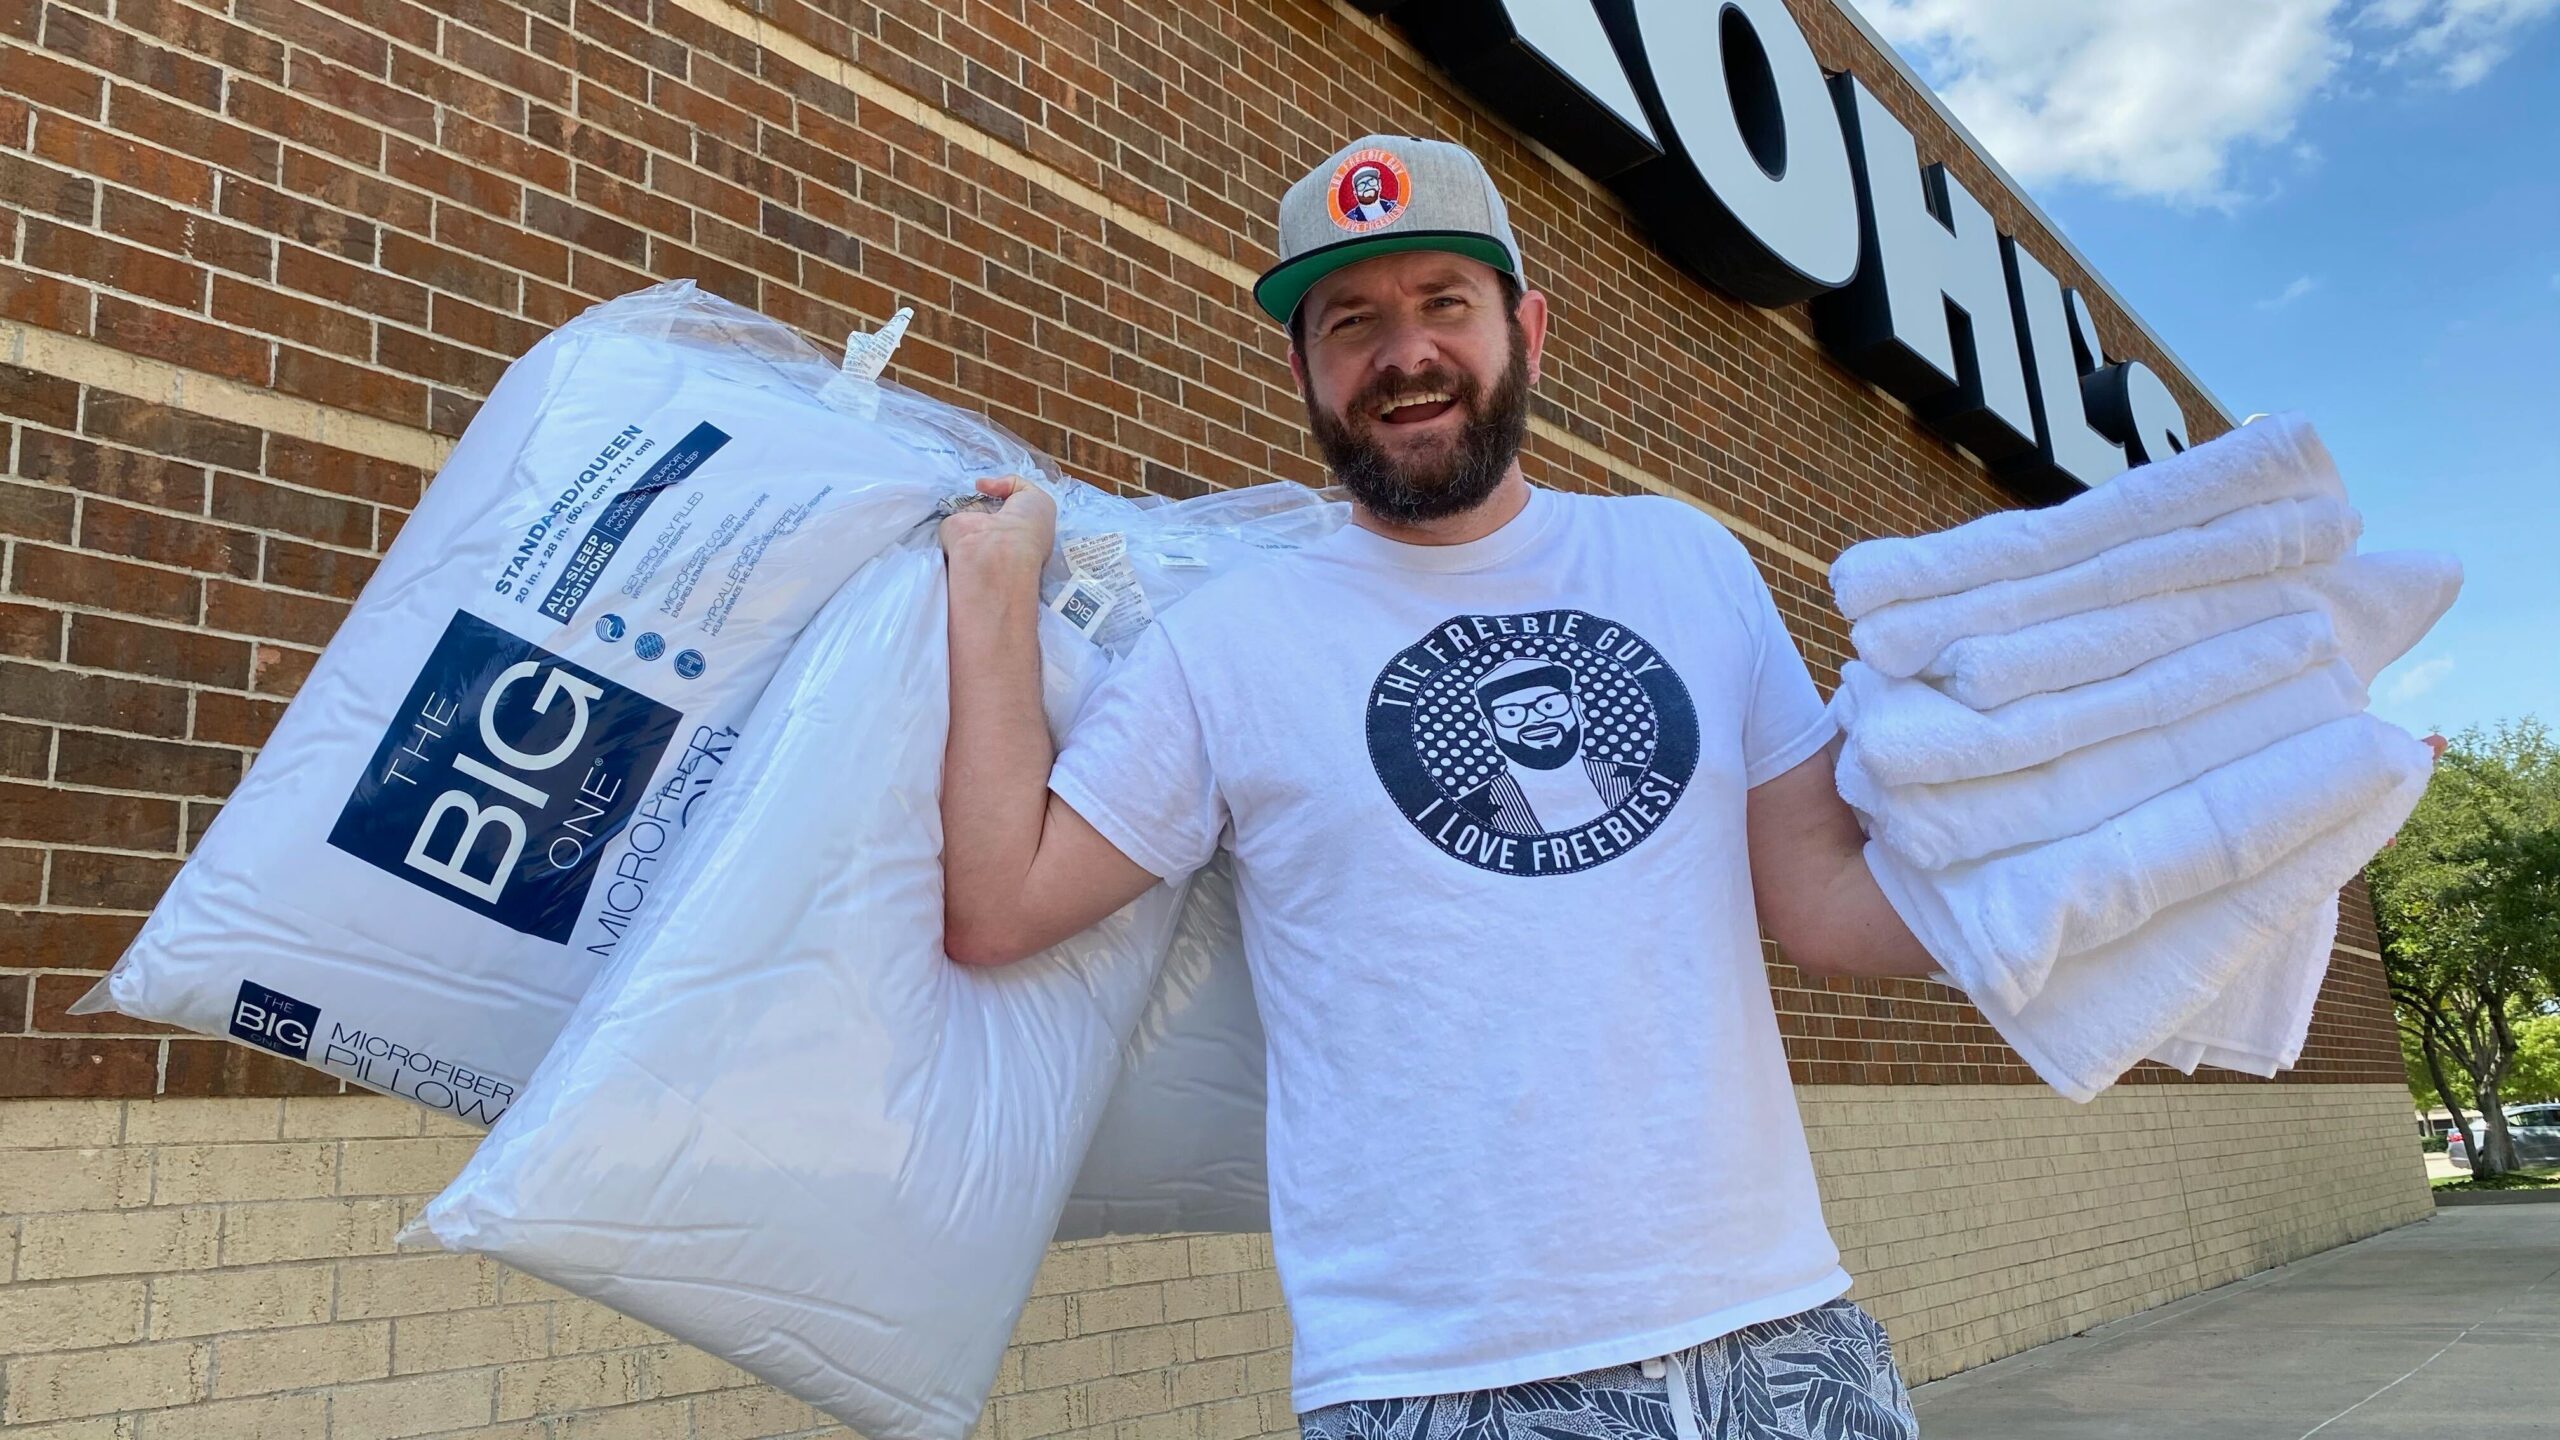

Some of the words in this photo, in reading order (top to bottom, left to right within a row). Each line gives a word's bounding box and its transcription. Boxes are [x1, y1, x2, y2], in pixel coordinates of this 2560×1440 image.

[614, 519, 627, 532] NO
[678, 451, 699, 471] SLEEP
[653, 453, 685, 482] SUPPORT
[495, 424, 643, 595] STANDARD/QUEEN
[515, 588, 529, 604] 20
[527, 571, 540, 586] in.
[539, 561, 547, 569] x
[544, 542, 558, 559] 28
[554, 527, 569, 541] in.
[592, 483, 608, 500] cm
[608, 476, 616, 484] x
[613, 457, 635, 475] 71.1
[635, 438, 655, 456] cm)
[621, 521, 676, 596] GENEROUSLY
[672, 491, 704, 523] FILLED
[705, 513, 738, 548] COVER
[547, 534, 600, 614] ALL-SLEEP
[558, 541, 614, 618] POSITIONS
[1067, 598, 1094, 622] BIG
[1376, 656, 1431, 708] THE
[1423, 613, 1584, 664] FREEBIE
[1595, 626, 1663, 677] GUY
[383, 691, 458, 785] THE
[403, 660, 604, 905] BIG
[1415, 797, 1444, 822] I
[1435, 813, 1519, 871] LOVE
[1532, 770, 1681, 872] FREEBIES!
[235, 1000, 309, 1050] BIG
[263, 993, 295, 1014] THE
[324, 1044, 506, 1125] PILLOW
[331, 1022, 514, 1104] MICROFIBER
